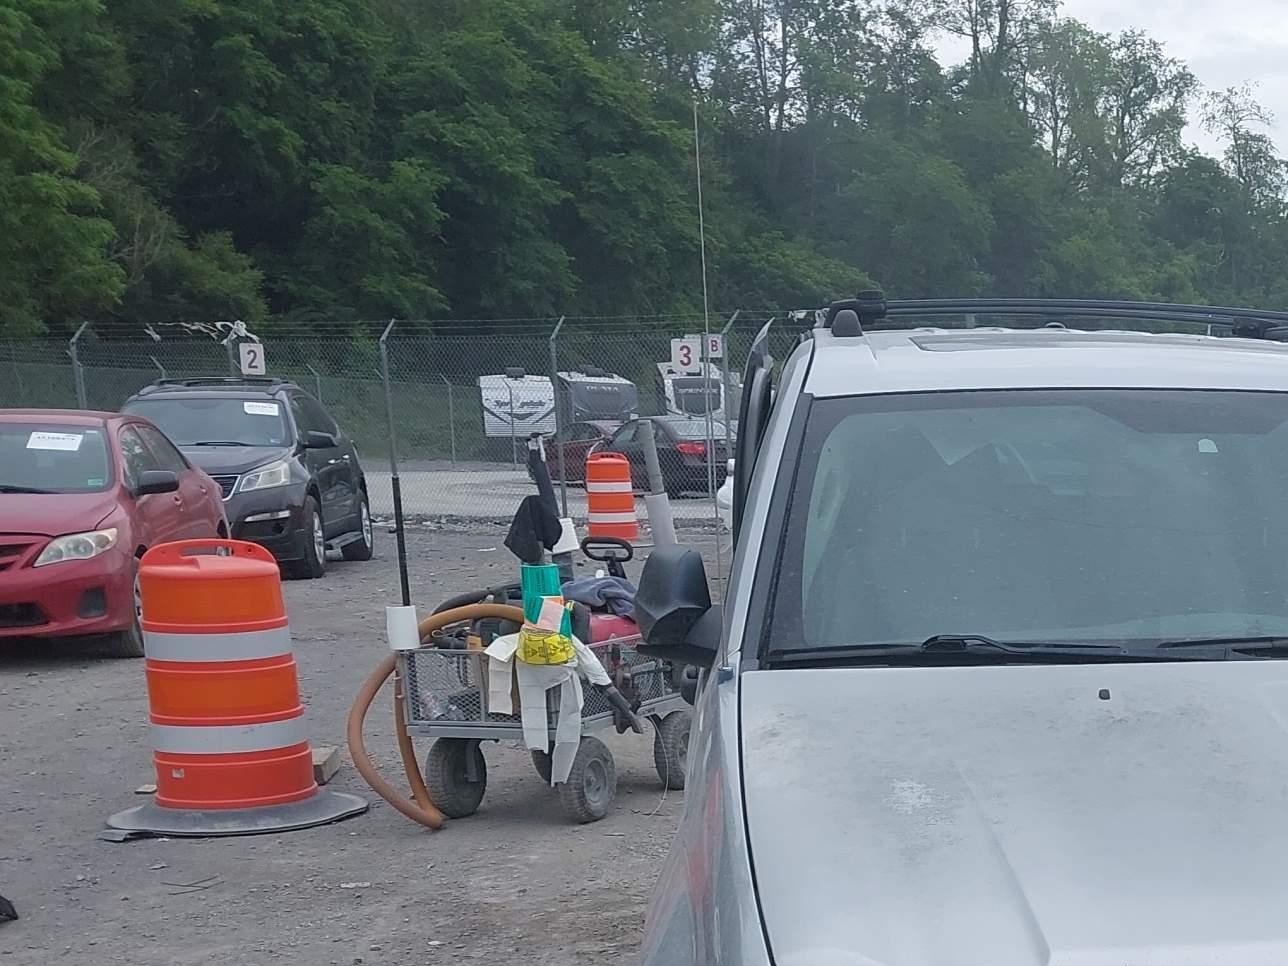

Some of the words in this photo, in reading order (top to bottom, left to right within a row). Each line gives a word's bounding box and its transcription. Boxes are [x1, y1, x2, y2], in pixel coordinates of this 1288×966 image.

[680, 345, 692, 366] 3
[710, 340, 719, 352] B
[247, 349, 258, 369] 2
